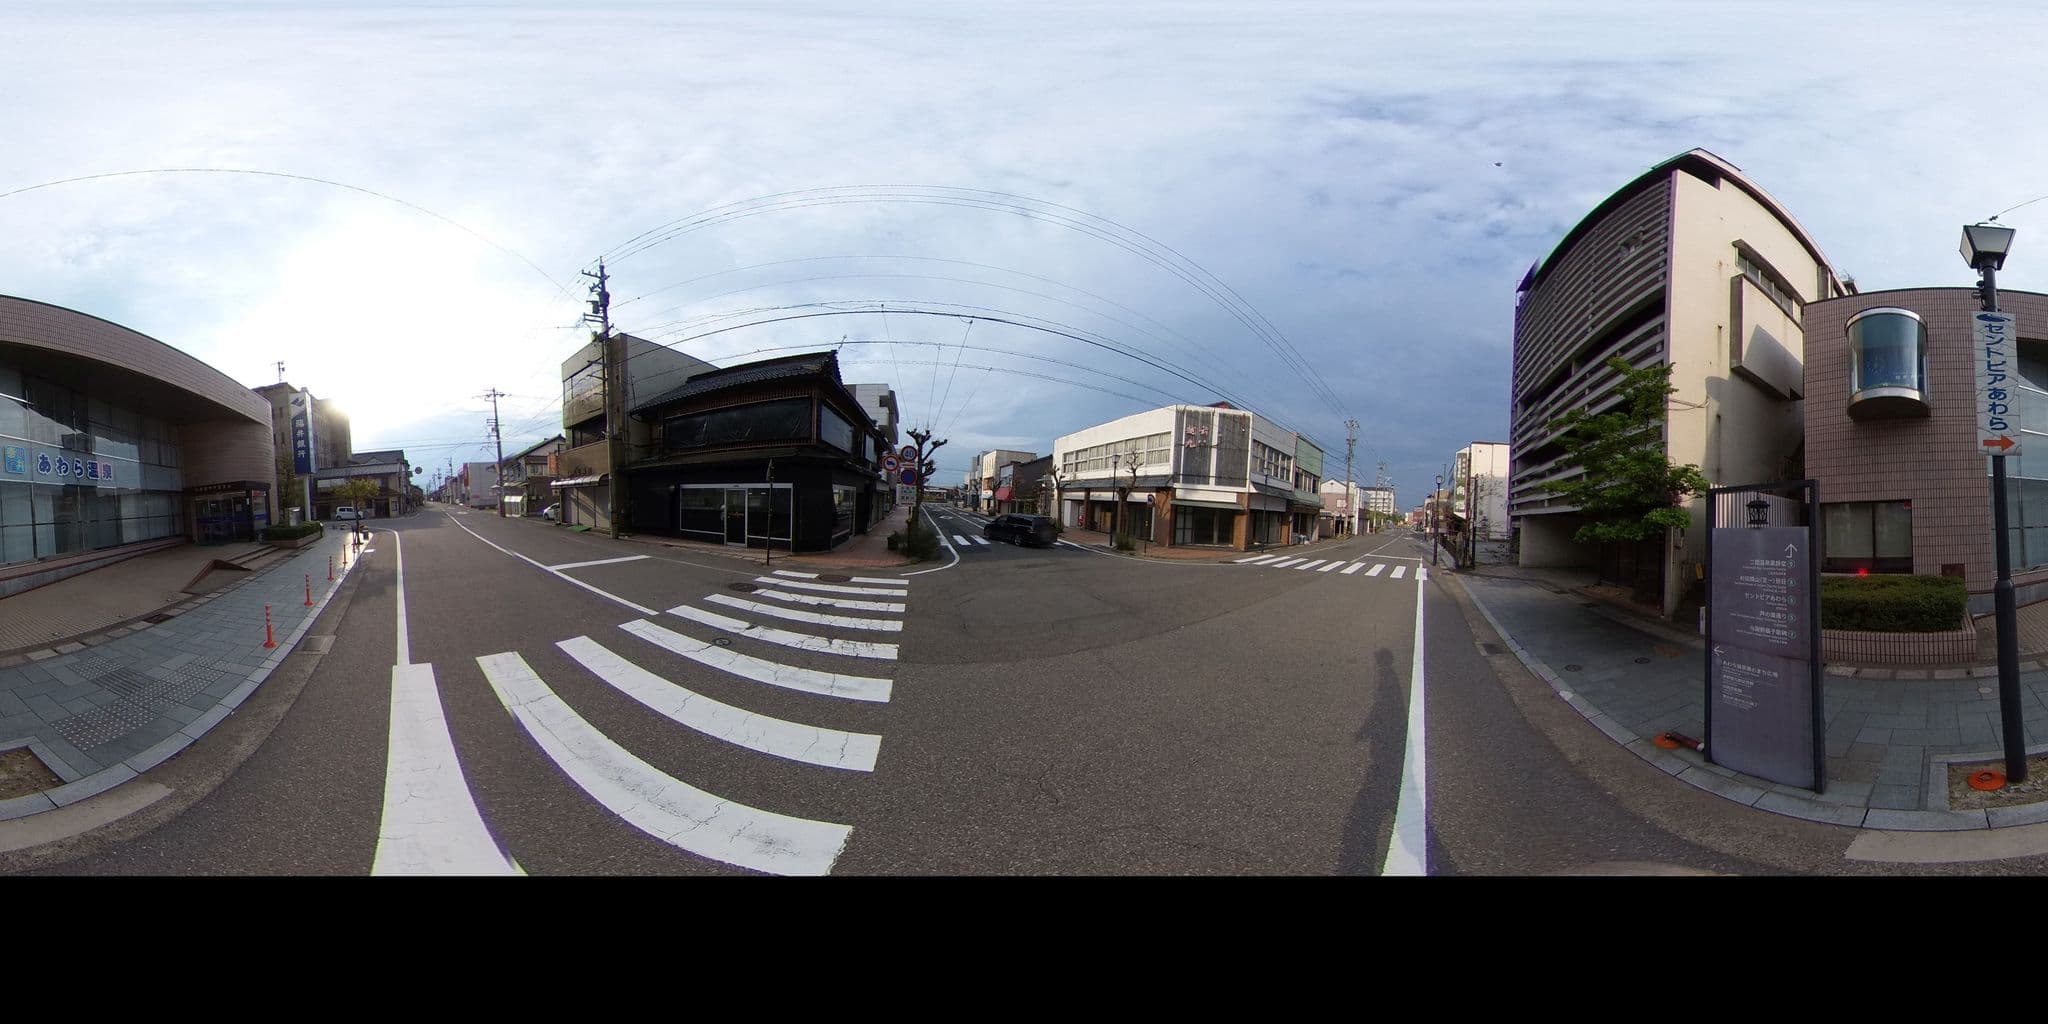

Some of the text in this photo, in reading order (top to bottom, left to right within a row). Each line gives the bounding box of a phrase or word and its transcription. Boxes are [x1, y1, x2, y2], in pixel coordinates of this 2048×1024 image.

[1984, 323, 2009, 432] セントピアあわら
[38, 452, 113, 481] あわら温泉
[904, 449, 914, 459] 40
